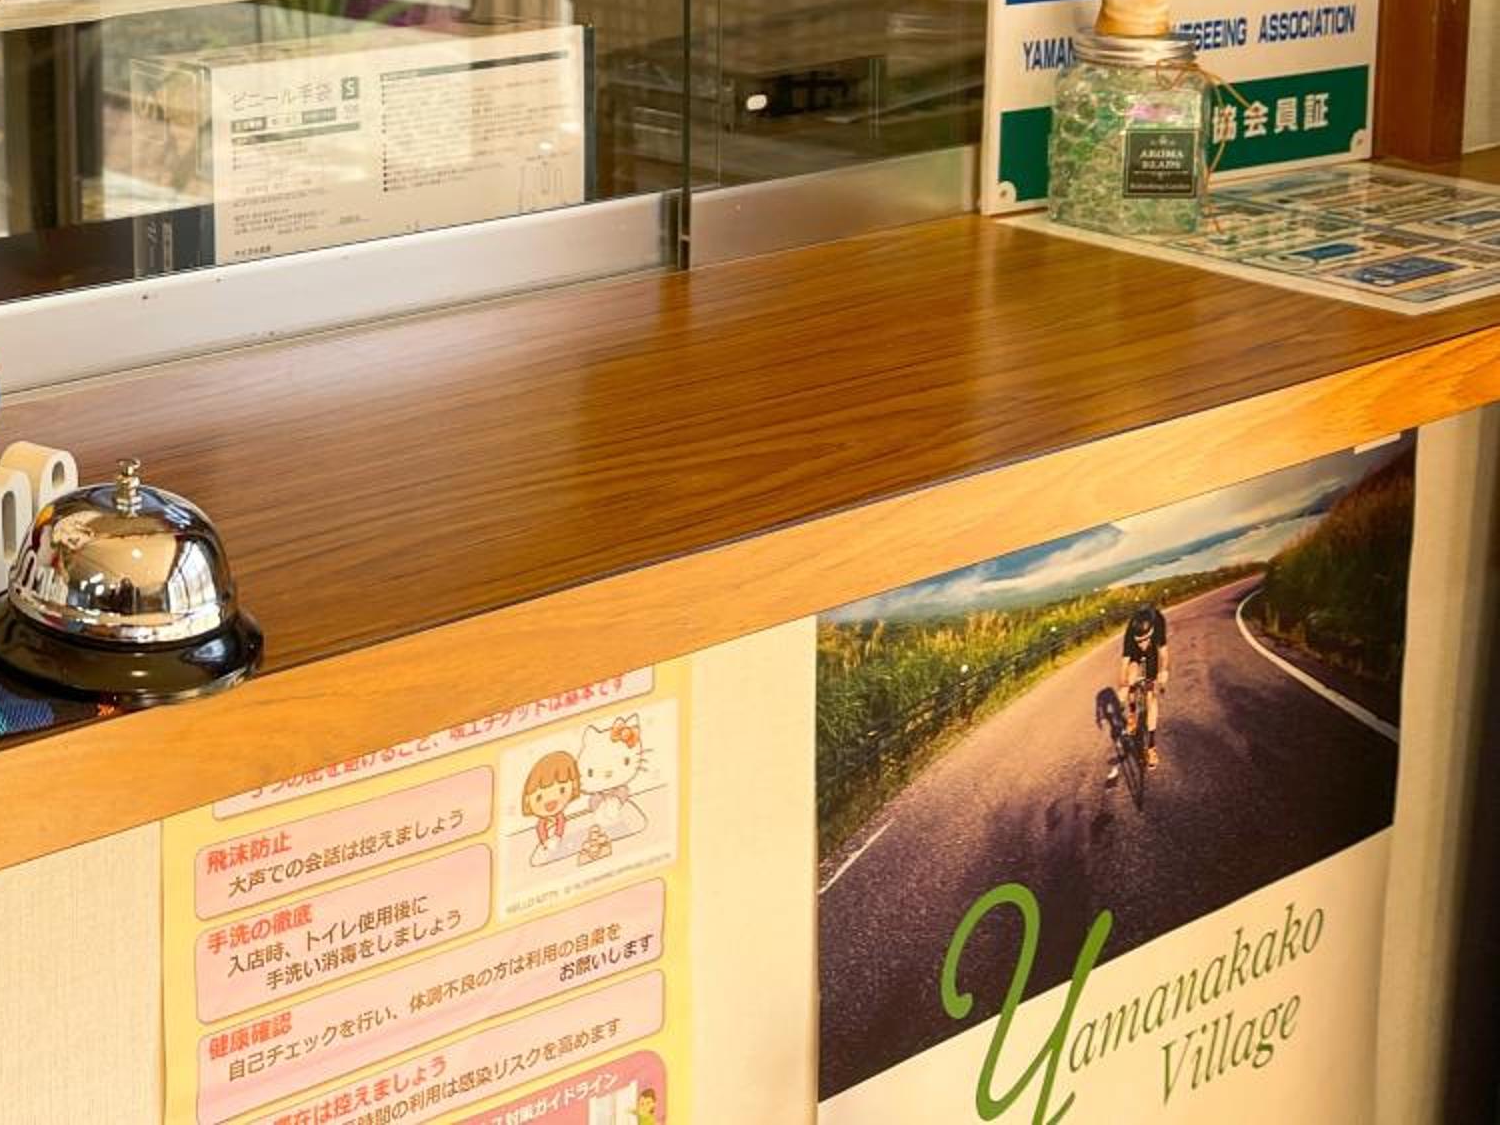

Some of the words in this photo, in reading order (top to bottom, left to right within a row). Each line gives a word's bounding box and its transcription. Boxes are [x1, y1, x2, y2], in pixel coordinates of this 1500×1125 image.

[1258, 5, 1356, 43] ASSOCIATION
[207, 831, 293, 875] 飛沫防止
[228, 809, 464, 897] 大声での会話は控えましょう
[207, 903, 313, 955] 手洗の徹底
[266, 909, 462, 990] 手洗い消毒をしましょう
[559, 933, 654, 982] お願いします
[940, 882, 1324, 1125] Yamanakako
[209, 1011, 293, 1061] 健康確認
[1161, 994, 1300, 1106] Village
